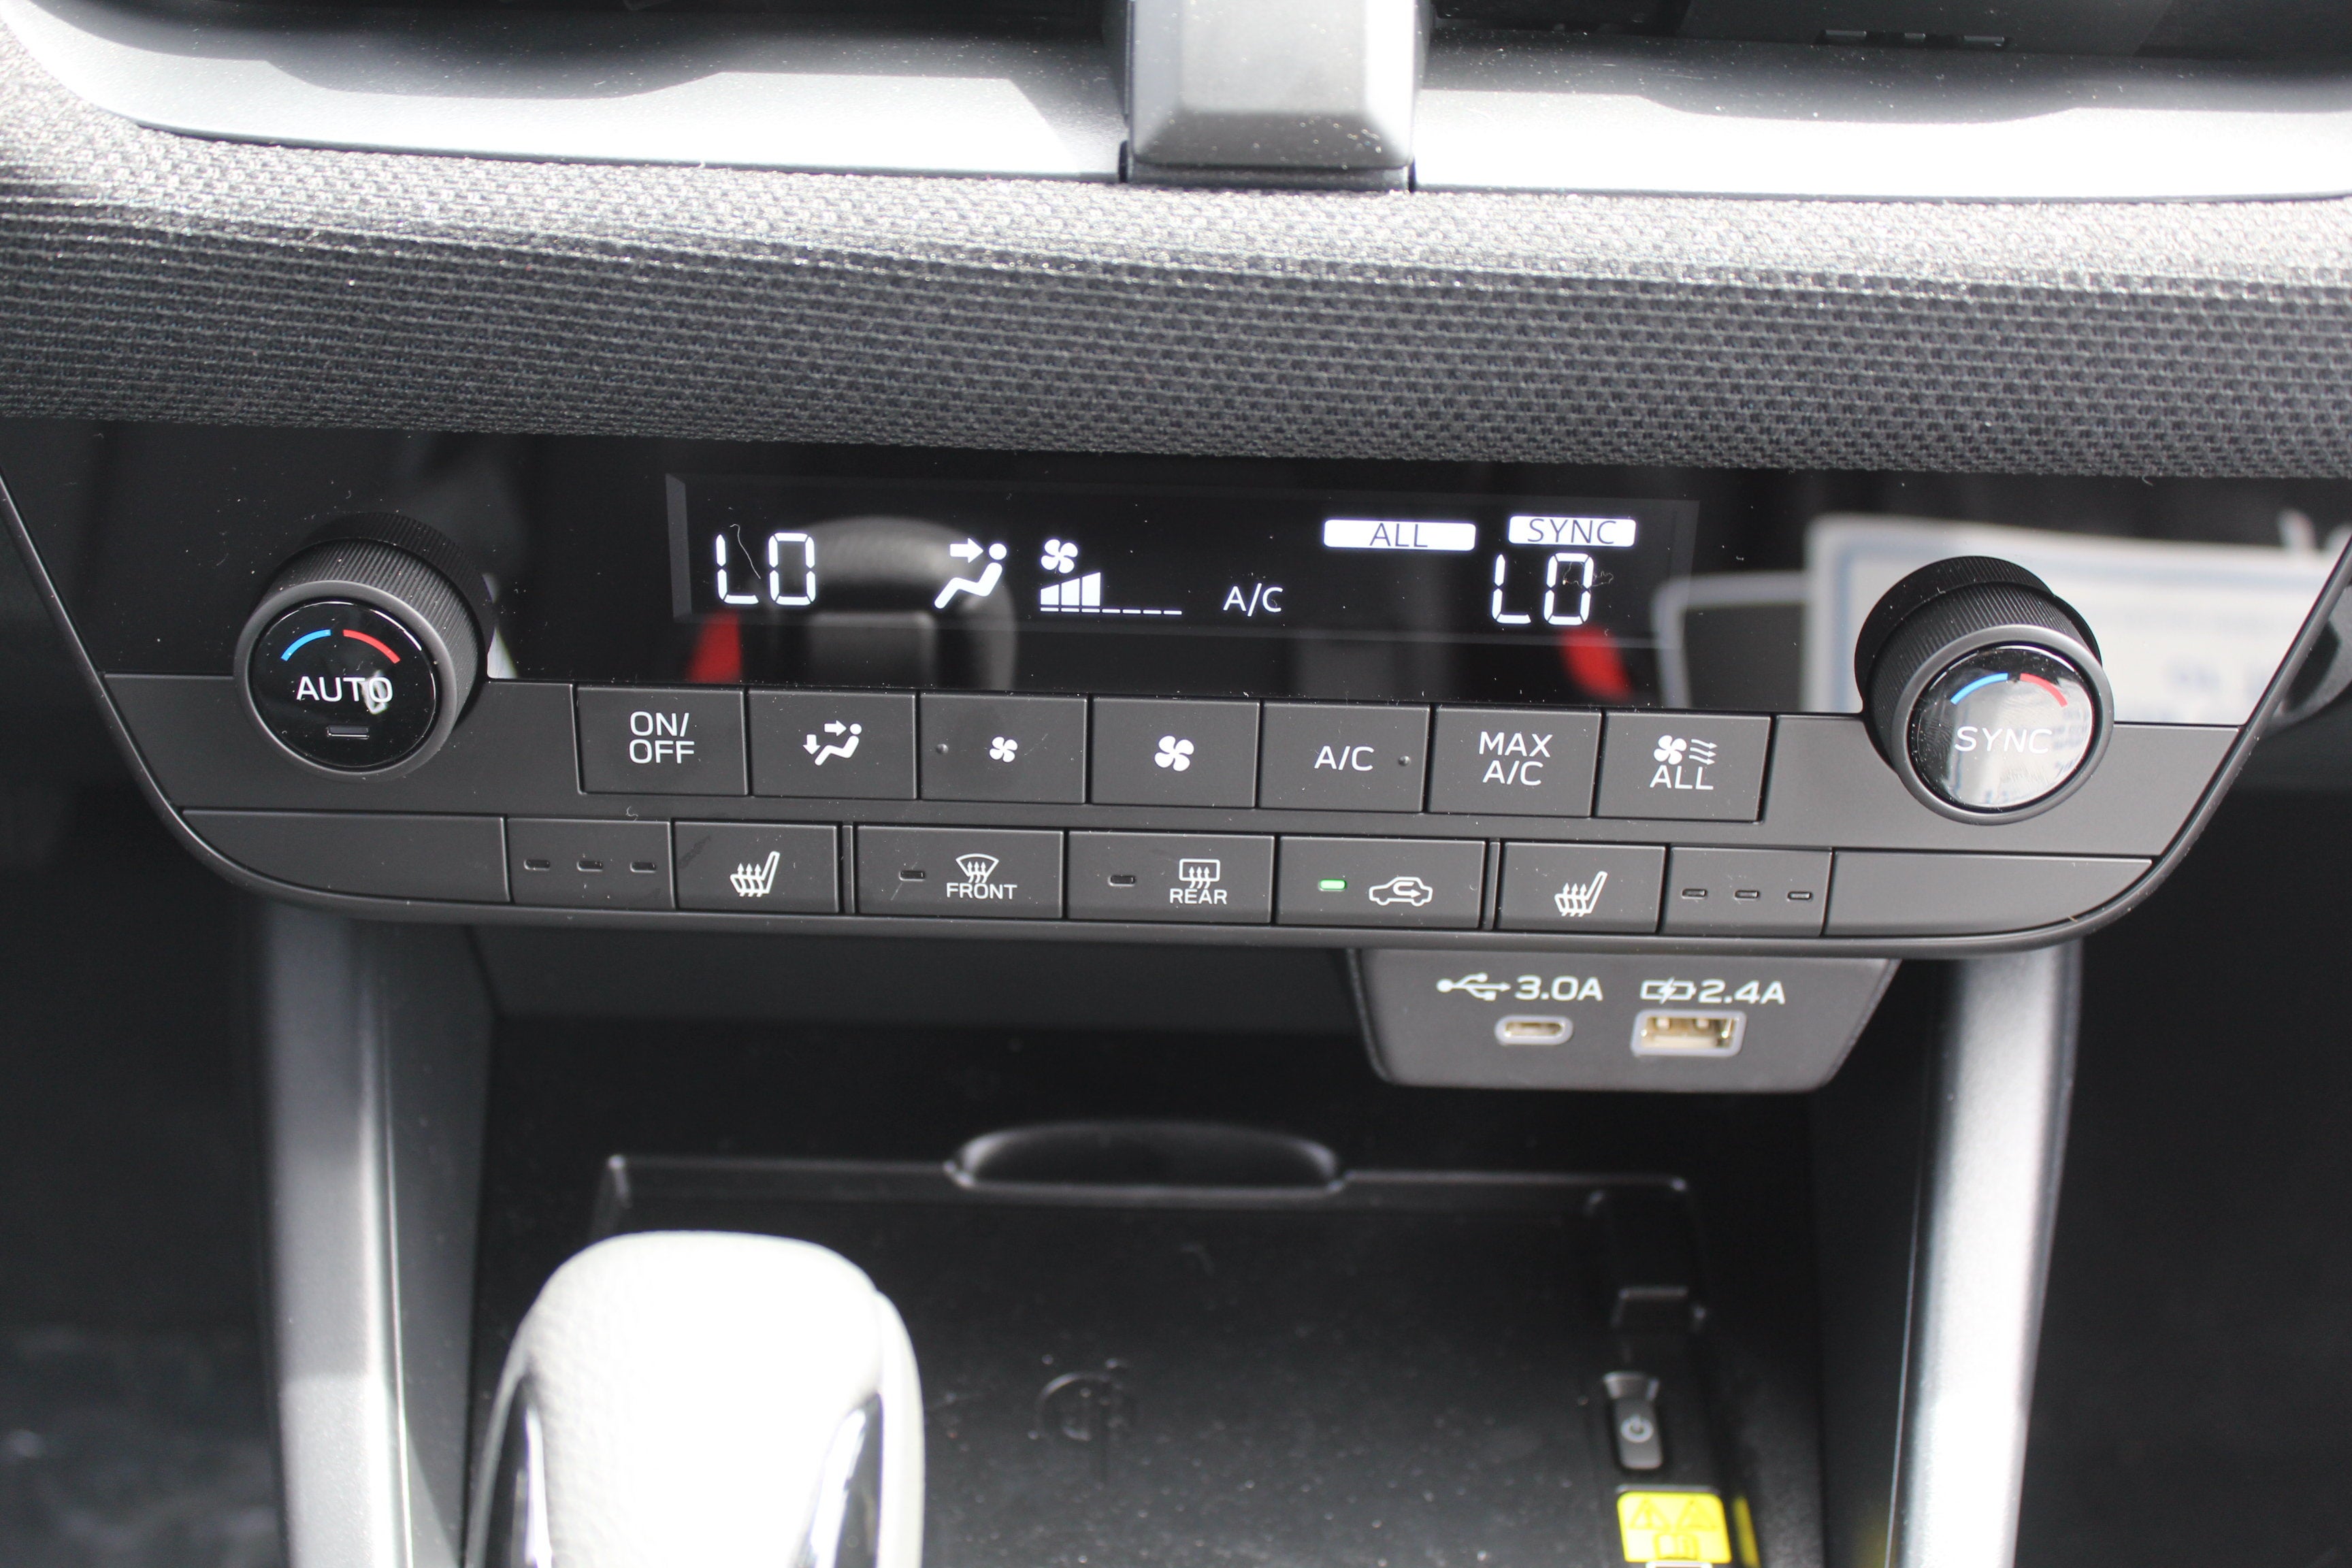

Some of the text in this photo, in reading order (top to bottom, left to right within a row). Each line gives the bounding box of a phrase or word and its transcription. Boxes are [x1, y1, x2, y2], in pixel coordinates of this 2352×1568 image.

[1369, 522, 1428, 547] ALL
[1527, 519, 1617, 544] SYNC
[716, 533, 816, 606] LO
[1223, 583, 1284, 617] A/C
[1492, 553, 1595, 626] LO
[296, 676, 393, 703] AUTO
[629, 712, 690, 737] ON/
[628, 738, 696, 764] OFF
[1478, 732, 1554, 758] MAX
[1955, 725, 2053, 754] SYNC
[1314, 746, 1375, 772] A/C
[1482, 760, 1544, 787] A/C
[1650, 764, 1714, 791] ALL
[946, 882, 1018, 900] FRONT
[1169, 887, 1228, 905] REAR
[1514, 975, 1604, 1002] 3.0A
[1698, 979, 1787, 1005] 2.4A
